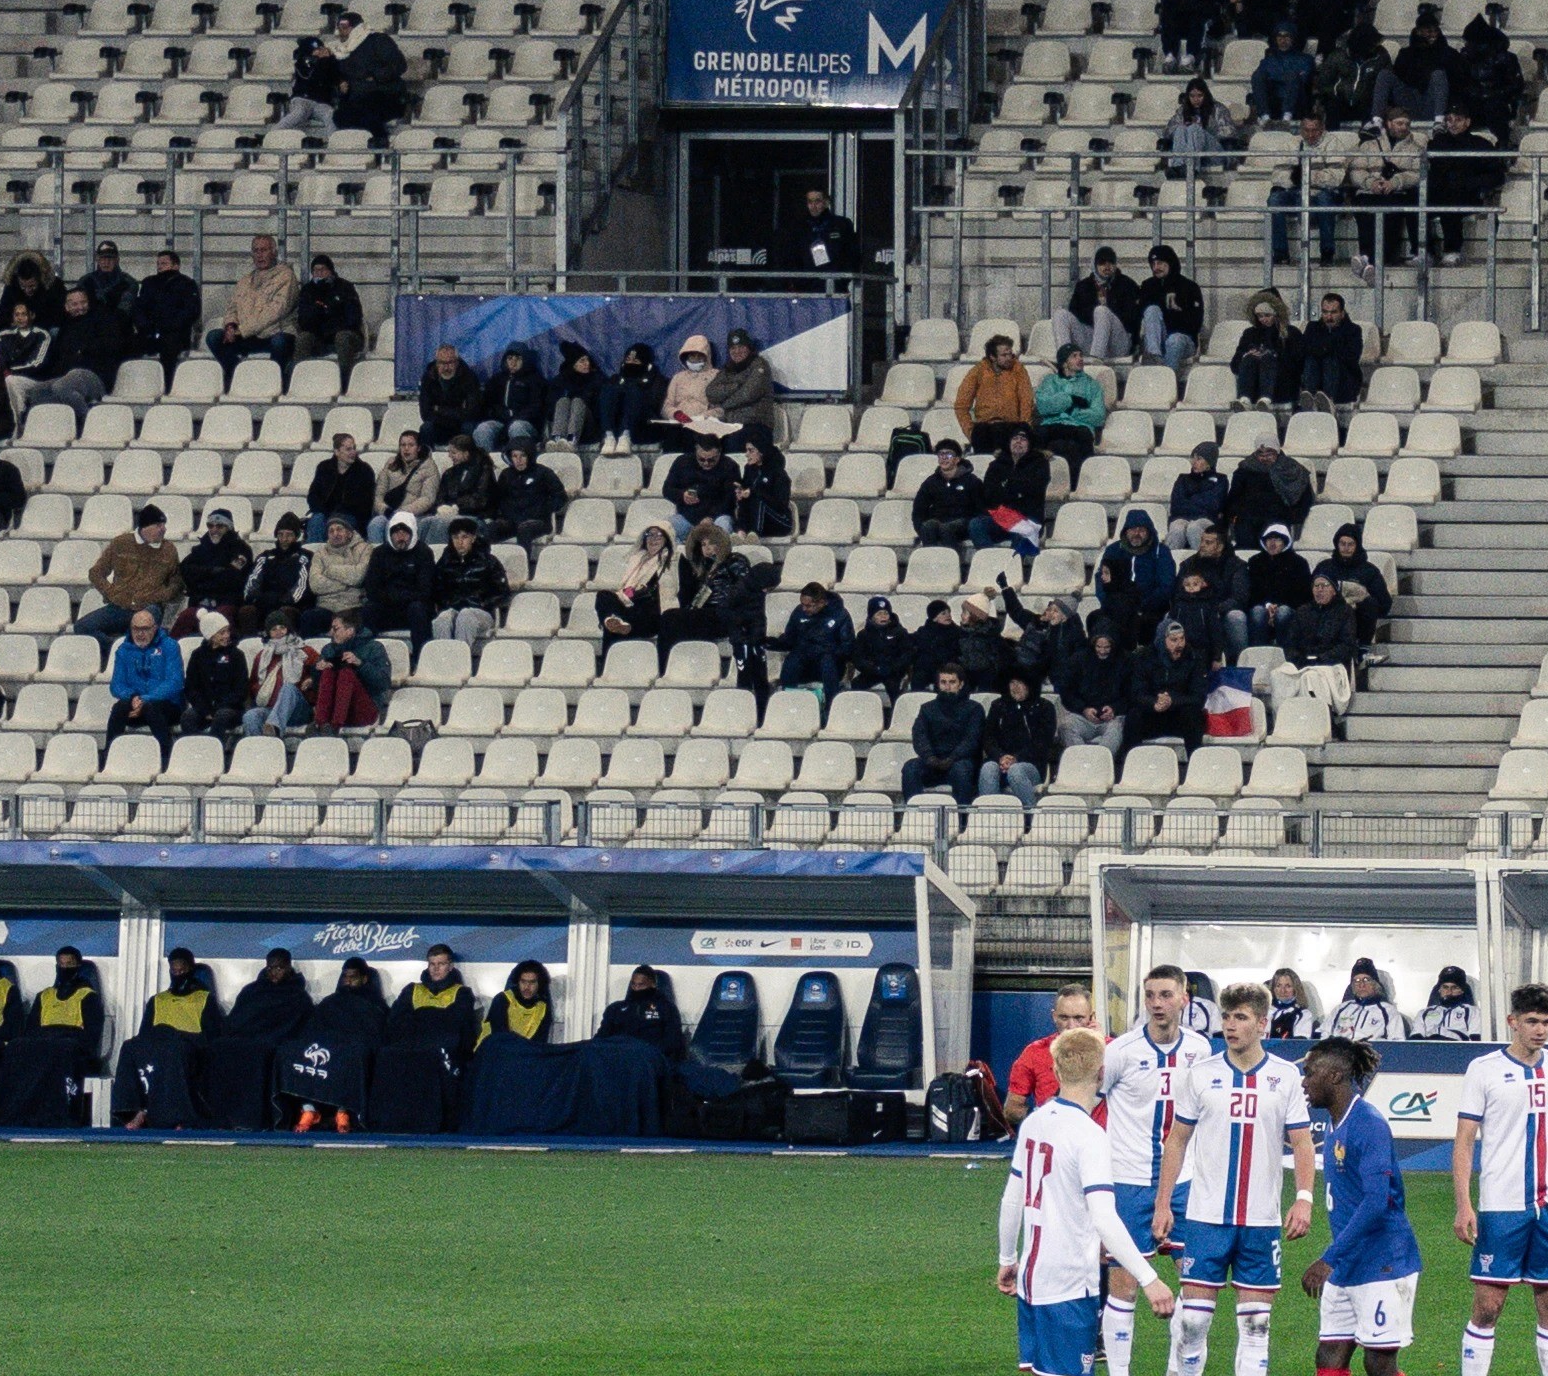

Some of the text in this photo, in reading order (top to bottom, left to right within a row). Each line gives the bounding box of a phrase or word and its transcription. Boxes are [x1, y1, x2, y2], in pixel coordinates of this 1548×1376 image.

[715, 73, 830, 99] MÉTROPOLE
[1161, 1072, 1171, 1096] 3
[1527, 1083, 1546, 1109] 15
[1230, 1092, 1258, 1118] 20
[1024, 1137, 1054, 1210] 17
[1374, 1299, 1386, 1327] 6
